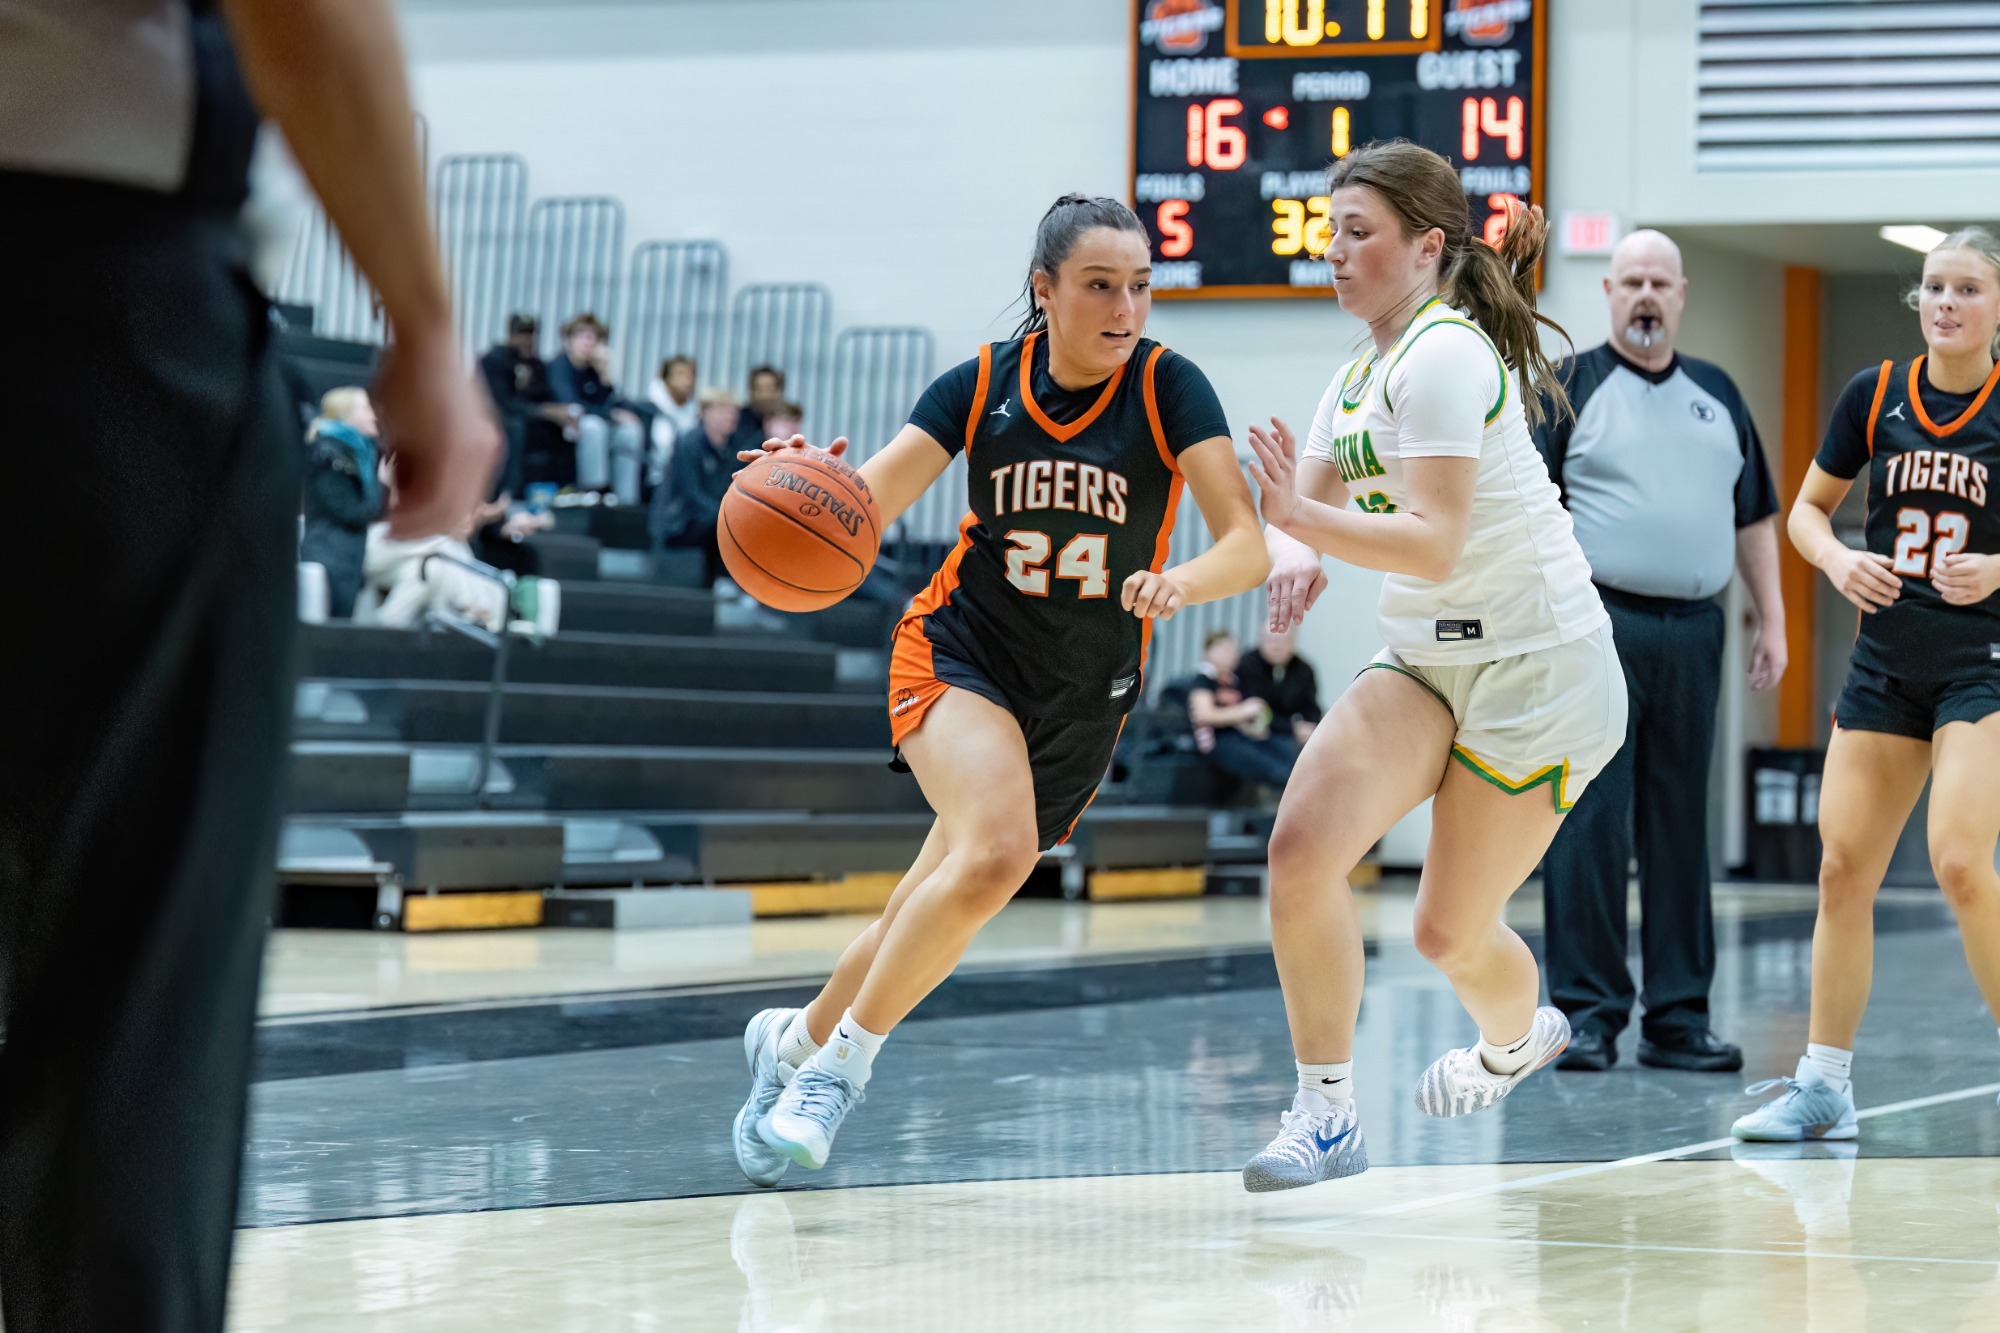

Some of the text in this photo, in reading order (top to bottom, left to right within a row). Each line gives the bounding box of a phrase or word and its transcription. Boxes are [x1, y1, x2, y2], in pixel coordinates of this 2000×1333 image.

[1149, 58, 1239, 97] HOME
[1292, 71, 1370, 101] PERIOD
[1416, 49, 1521, 90] GUEST
[1187, 98, 1247, 171] 16
[1332, 106, 1349, 157] 1
[1461, 95, 1524, 160] 14
[1157, 199, 1193, 257] 5
[764, 464, 864, 537] SPALDING
[990, 460, 1127, 525] TIGERS
[1886, 450, 1988, 507] TIGERS
[1004, 529, 1110, 599] 24
[1891, 507, 1971, 578] 22
[1466, 626, 1476, 635] M
